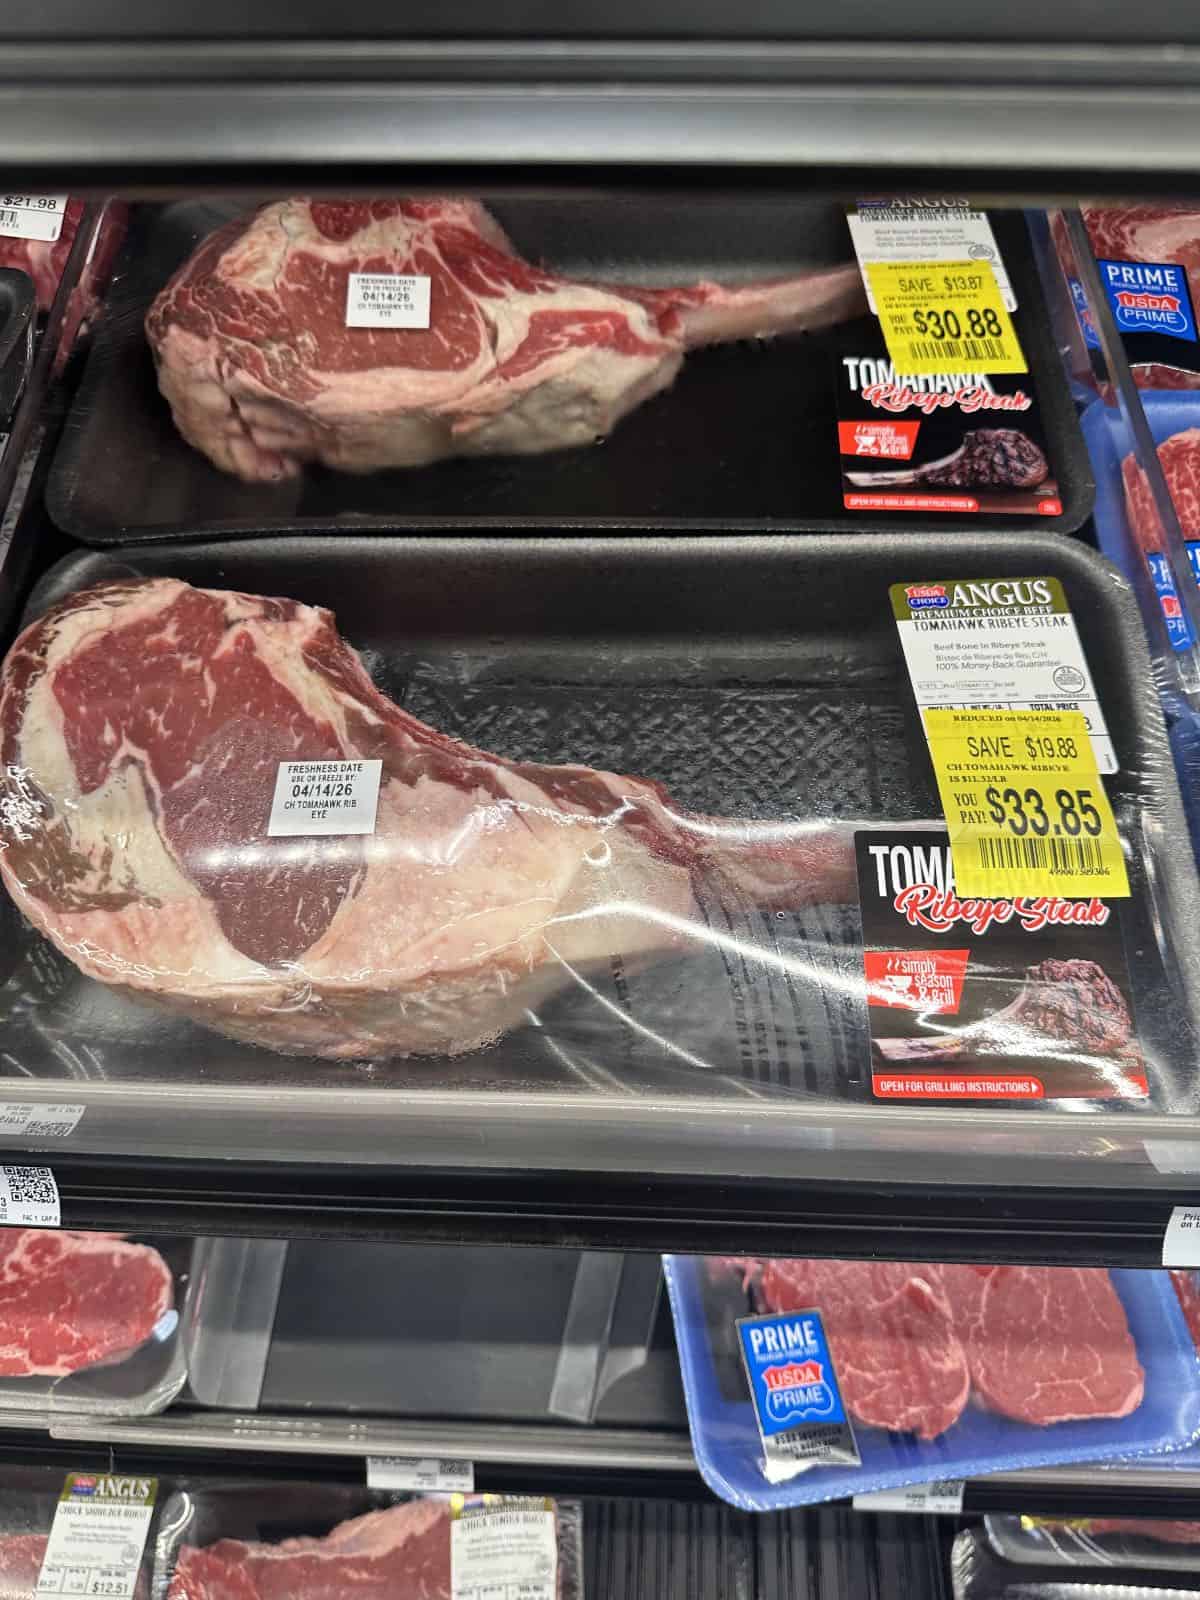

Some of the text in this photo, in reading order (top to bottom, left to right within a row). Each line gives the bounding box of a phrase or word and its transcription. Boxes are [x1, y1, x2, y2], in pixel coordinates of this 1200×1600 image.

[3, 195, 57, 209] $21.98
[1106, 264, 1179, 287] PRIME
[899, 276, 984, 293] SAVE $13.87
[362, 292, 410, 302] 04/14/26
[1123, 294, 1173, 310] USDA
[913, 308, 1003, 339] $30.88
[1124, 309, 1178, 324] PRIME
[913, 580, 1053, 608] USDA ANGUS
[910, 598, 949, 606] CHOICE
[911, 606, 1053, 620] PREMIUM CHOICE BEEF
[913, 616, 1069, 632] TOMAHAWK RIBEYE STEAK
[956, 642, 979, 650] Bone
[935, 662, 959, 672] 100%
[1029, 702, 1080, 711] TOTAL PRICE
[967, 735, 1078, 760] SAVE $19.88
[287, 763, 364, 774] FRESHNESS DATE
[967, 763, 1029, 771] TOMAHAWK
[291, 775, 305, 783] USE
[318, 774, 343, 782] FREEZE
[292, 783, 353, 797] 04/14/26
[284, 799, 358, 809] CH TOMAHAWK RIB
[953, 784, 1103, 837] YOU $33.85
[311, 809, 328, 819] EYE
[960, 810, 988, 824] PAY!
[894, 882, 1110, 935] Ribeye Steak
[901, 958, 937, 976] simply
[914, 974, 953, 988] season
[880, 1080, 1031, 1093] OPEN FOR GRILLING INSTRUCTIONS
[750, 1319, 817, 1355] PRIME
[770, 1366, 817, 1388] USDA
[772, 1384, 825, 1410] PRIME
[94, 1478, 152, 1497] ANGUS
